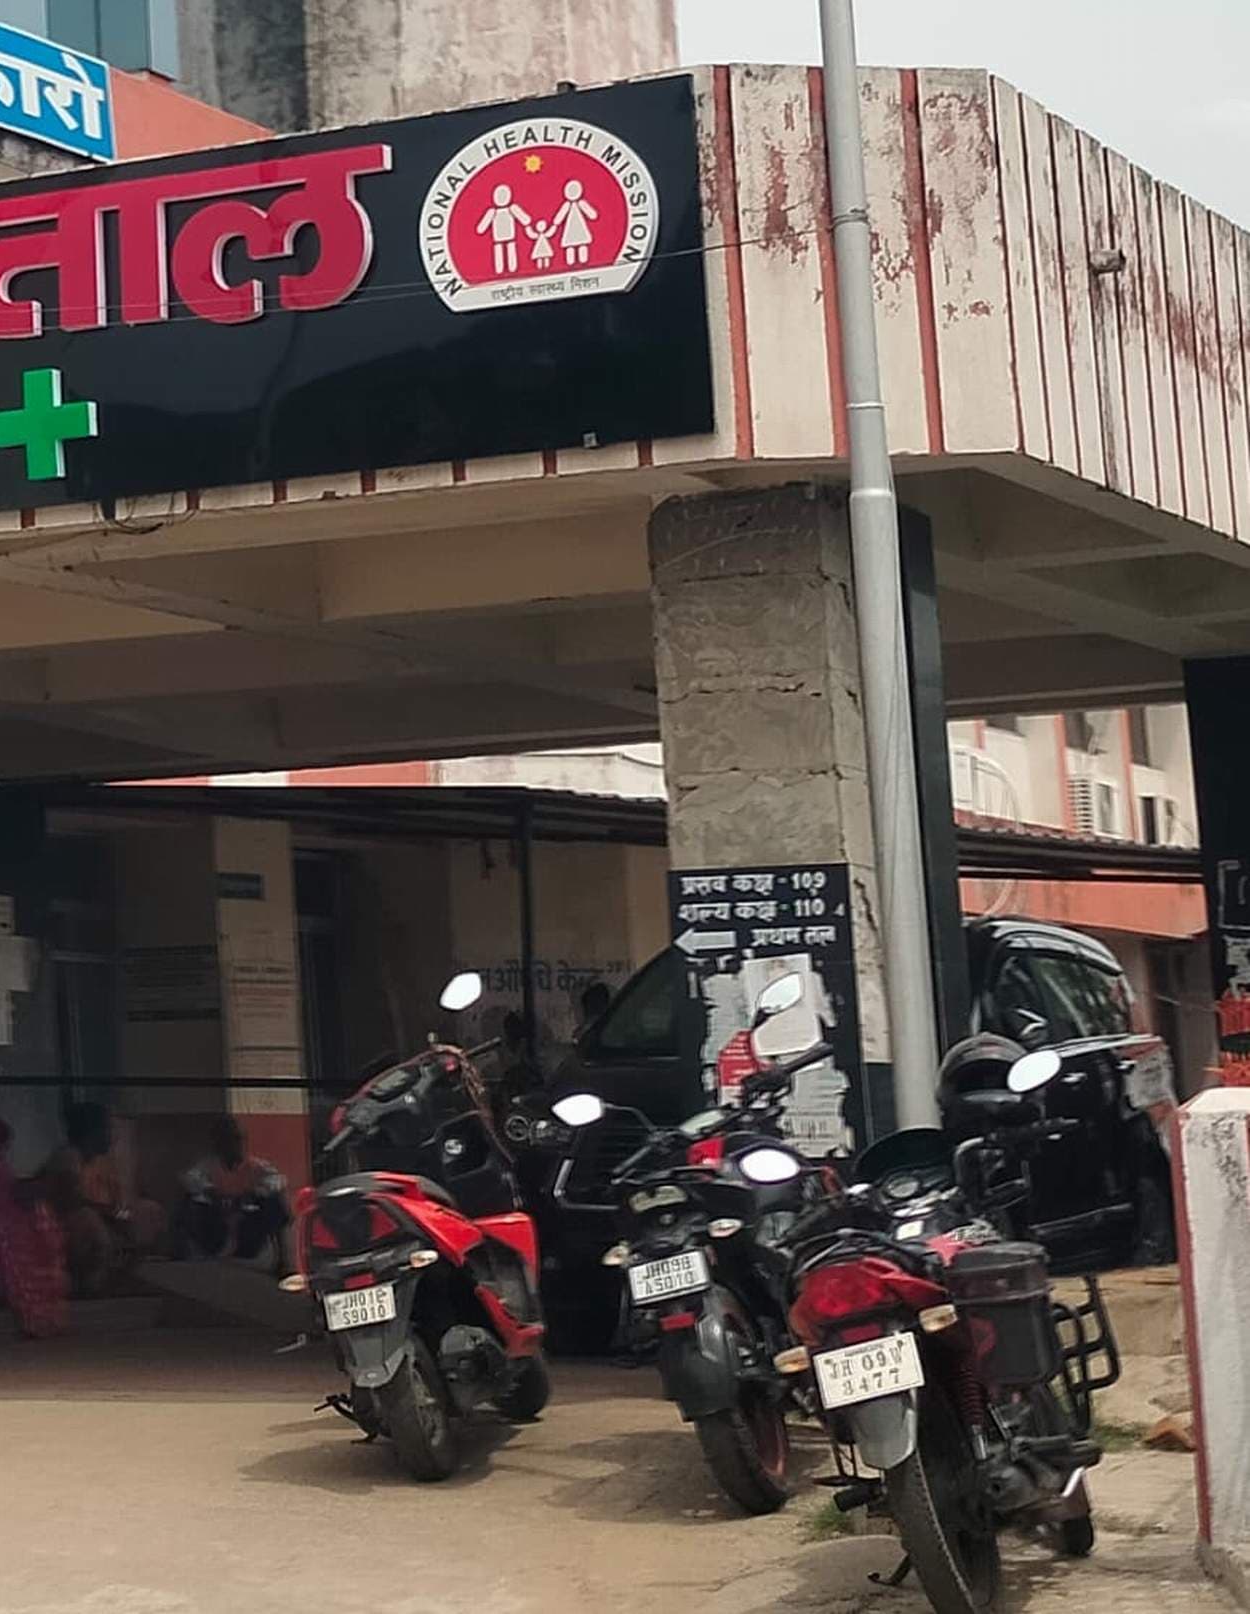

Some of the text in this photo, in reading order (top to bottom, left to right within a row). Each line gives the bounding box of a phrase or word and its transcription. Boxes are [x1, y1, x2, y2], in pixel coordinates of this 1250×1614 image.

[426, 124, 649, 297] NATIONAL HEALTH MISSION
[790, 871, 827, 890] 109
[794, 898, 825, 918] 110
